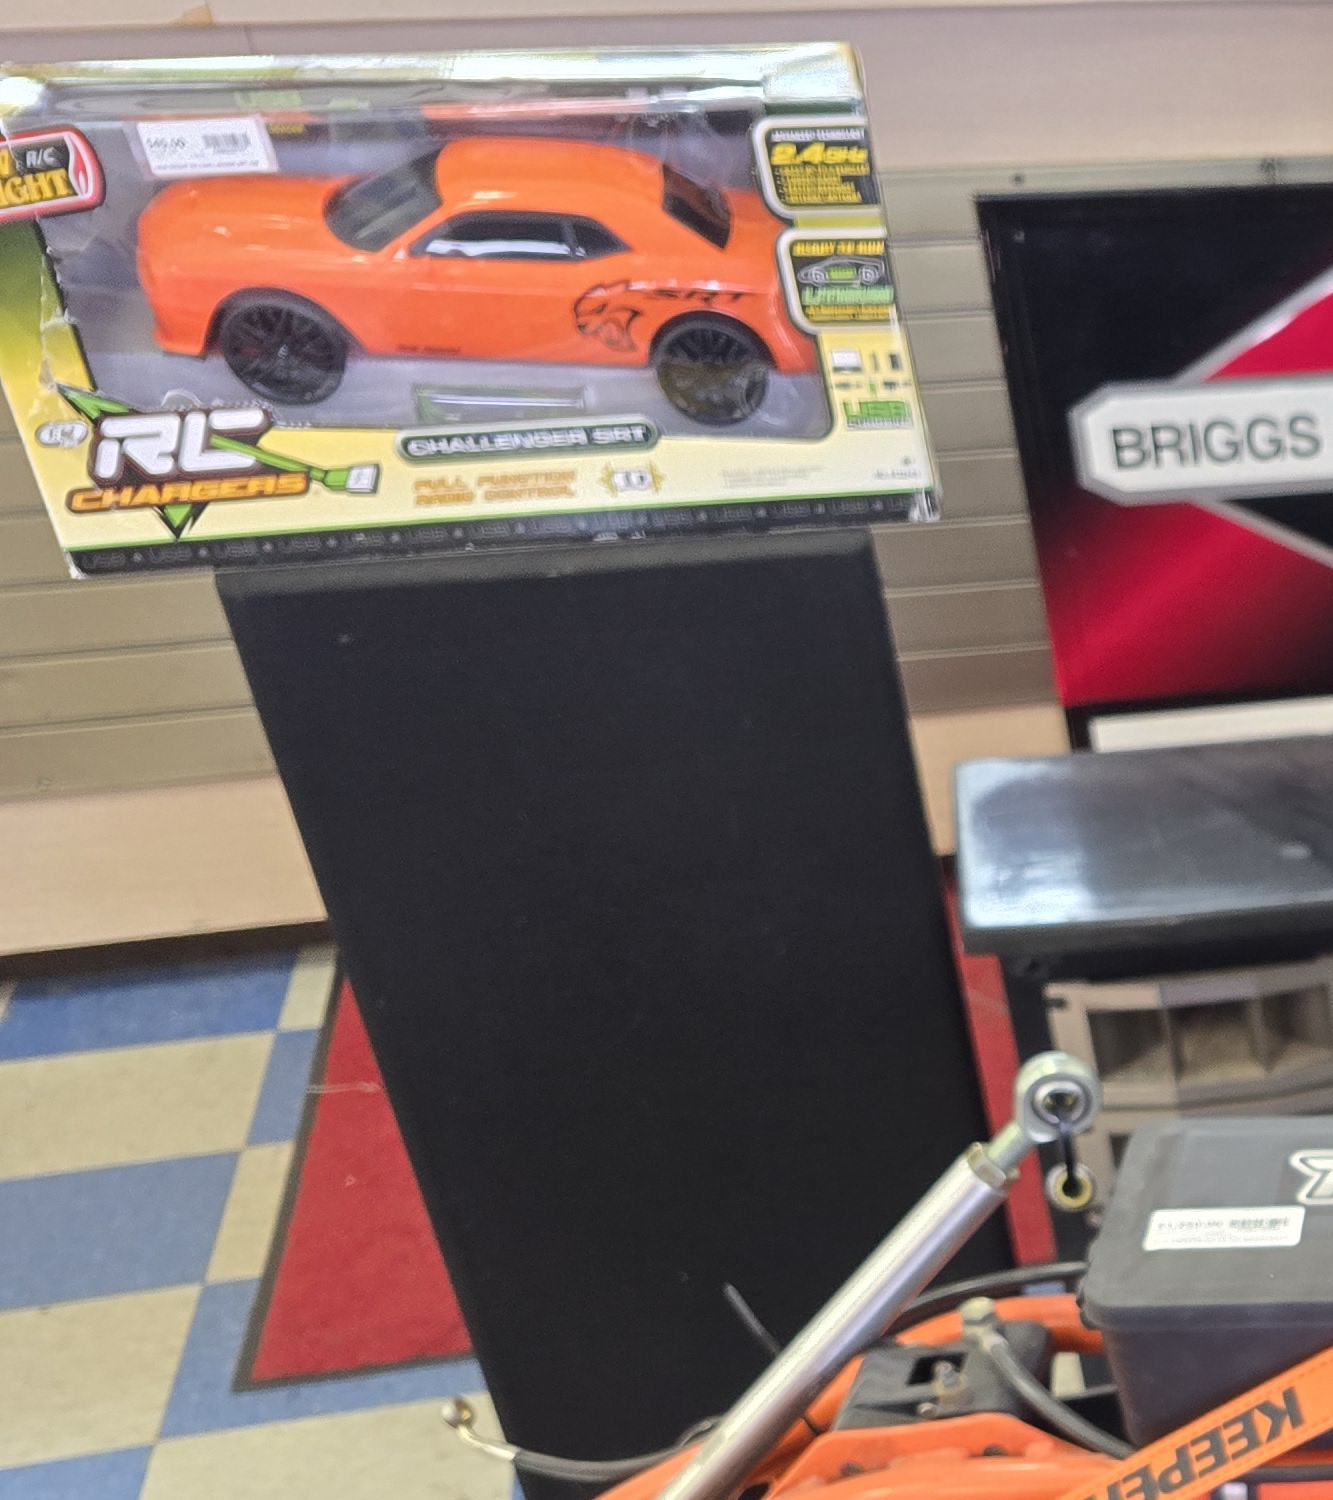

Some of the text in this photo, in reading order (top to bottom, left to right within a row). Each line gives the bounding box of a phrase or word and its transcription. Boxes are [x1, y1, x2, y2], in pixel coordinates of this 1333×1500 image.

[94, 407, 268, 479] RC
[407, 426, 647, 457] CHALLENGER SRT
[1112, 416, 1320, 469] BRIGGS
[69, 473, 306, 512] CHARGERS
